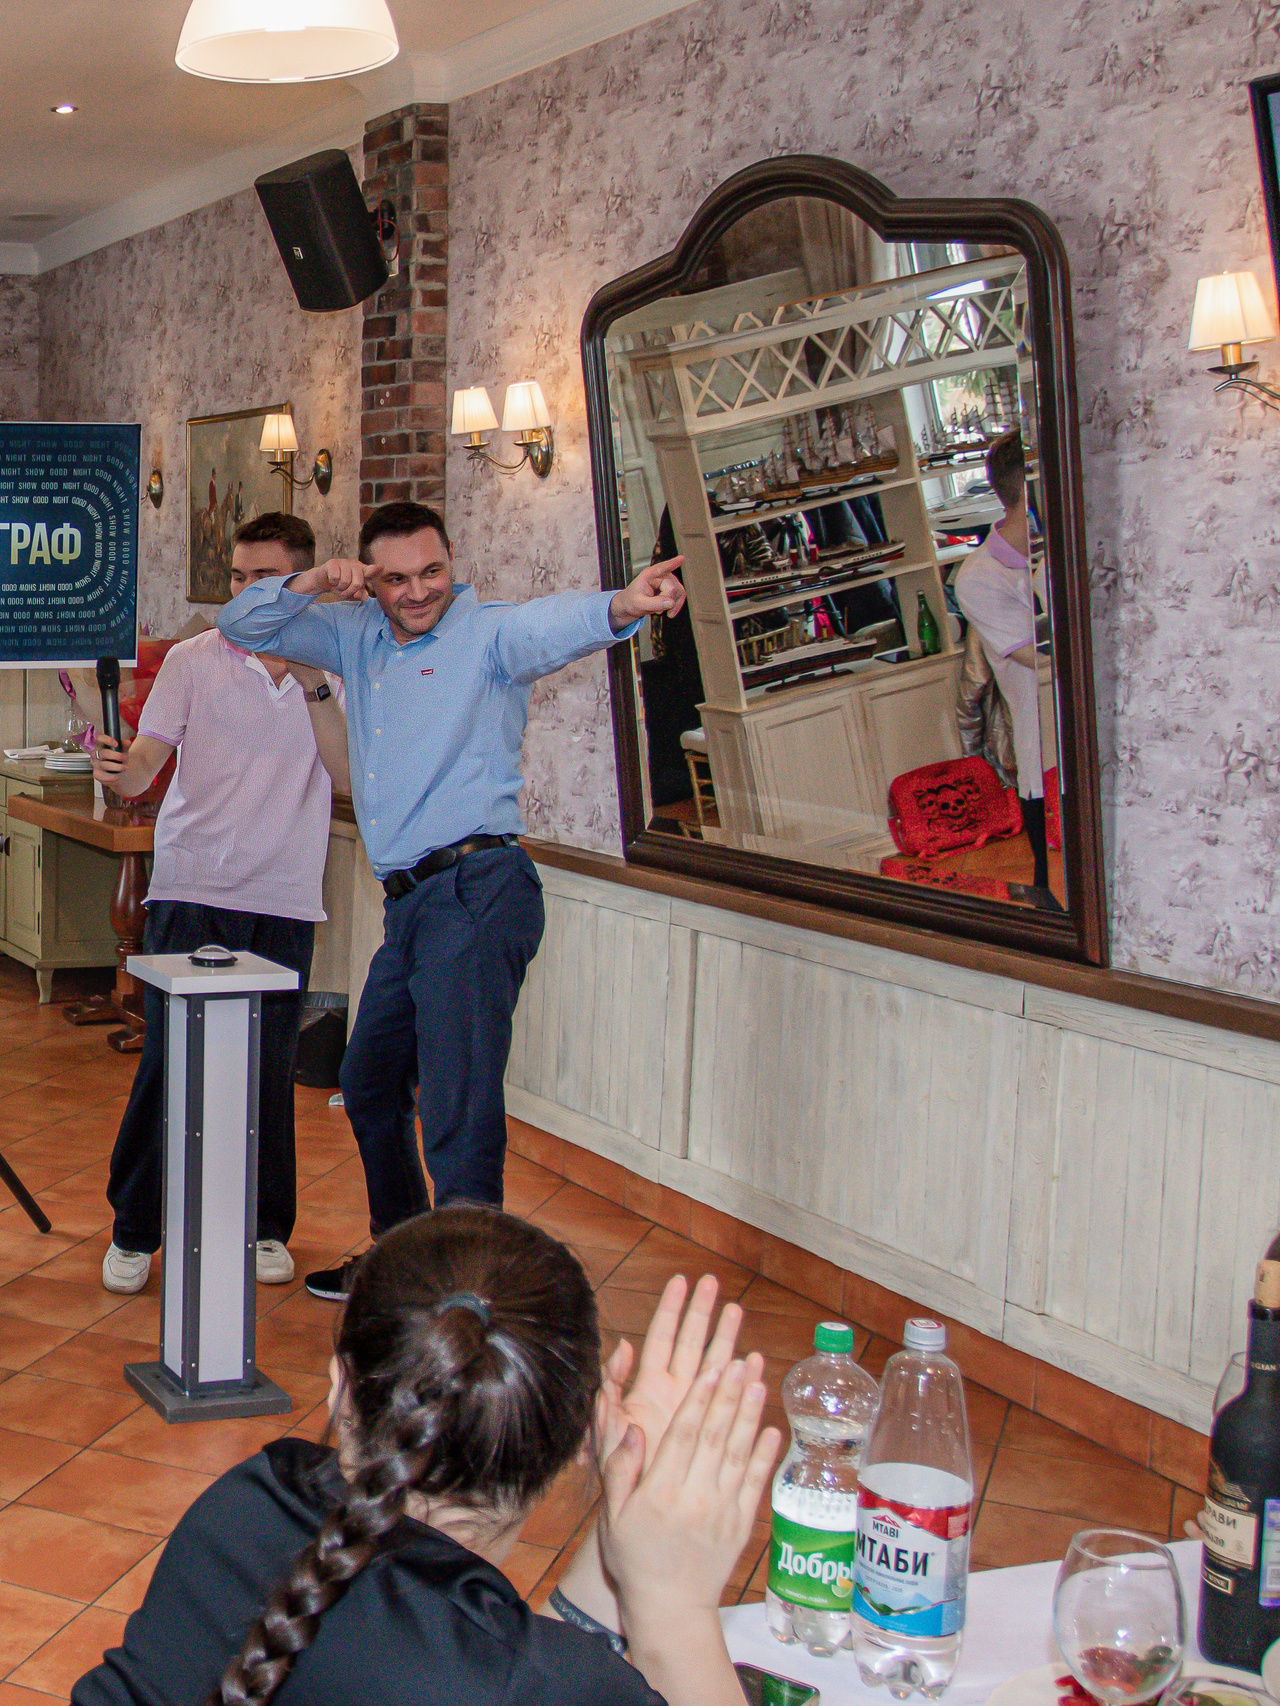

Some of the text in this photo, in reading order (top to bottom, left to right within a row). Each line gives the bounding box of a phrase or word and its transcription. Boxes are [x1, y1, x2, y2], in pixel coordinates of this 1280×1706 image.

[25, 468, 45, 476] SHOW
[50, 468, 68, 476] GOOD
[73, 468, 91, 476] NIGHT
[95, 469, 112, 483] GOOD
[19, 482, 37, 490] SHOW
[41, 482, 58, 490] GOOD
[63, 482, 80, 490] NIGHT
[83, 482, 100, 495] GOOD
[112, 480, 128, 504] NIGHT
[12, 496, 29, 504] SHOW
[32, 496, 49, 504] GOOD
[53, 496, 69, 504] NIGHT
[72, 496, 87, 508] GOOD
[99, 491, 114, 512] NIGHT
[86, 503, 101, 520] NIGHT
[108, 514, 117, 538] SHOW
[122, 508, 130, 534] SHOW
[95, 522, 103, 540] SHOW
[95, 542, 103, 558] GOOD
[108, 541, 116, 561] GOOD
[122, 541, 130, 565] GOOD
[90, 559, 102, 577] NIGHT
[74, 575, 92, 589] SHOW
[103, 564, 116, 587] NIGHT
[58, 583, 73, 591] GOOD
[117, 570, 129, 596] NIGHT
[68, 596, 85, 604] GOOD
[86, 585, 104, 602] SHOW
[7, 597, 24, 605] GOOD
[27, 597, 45, 605] SHOW
[48, 597, 66, 605] NIGHT
[99, 596, 117, 615] SHOW
[34, 611, 53, 619] SHOW
[56, 611, 76, 619] NIGHT
[78, 610, 96, 618] GOOD
[855, 1528, 929, 1577] МТАБИ
[777, 1541, 856, 1587] Добры
